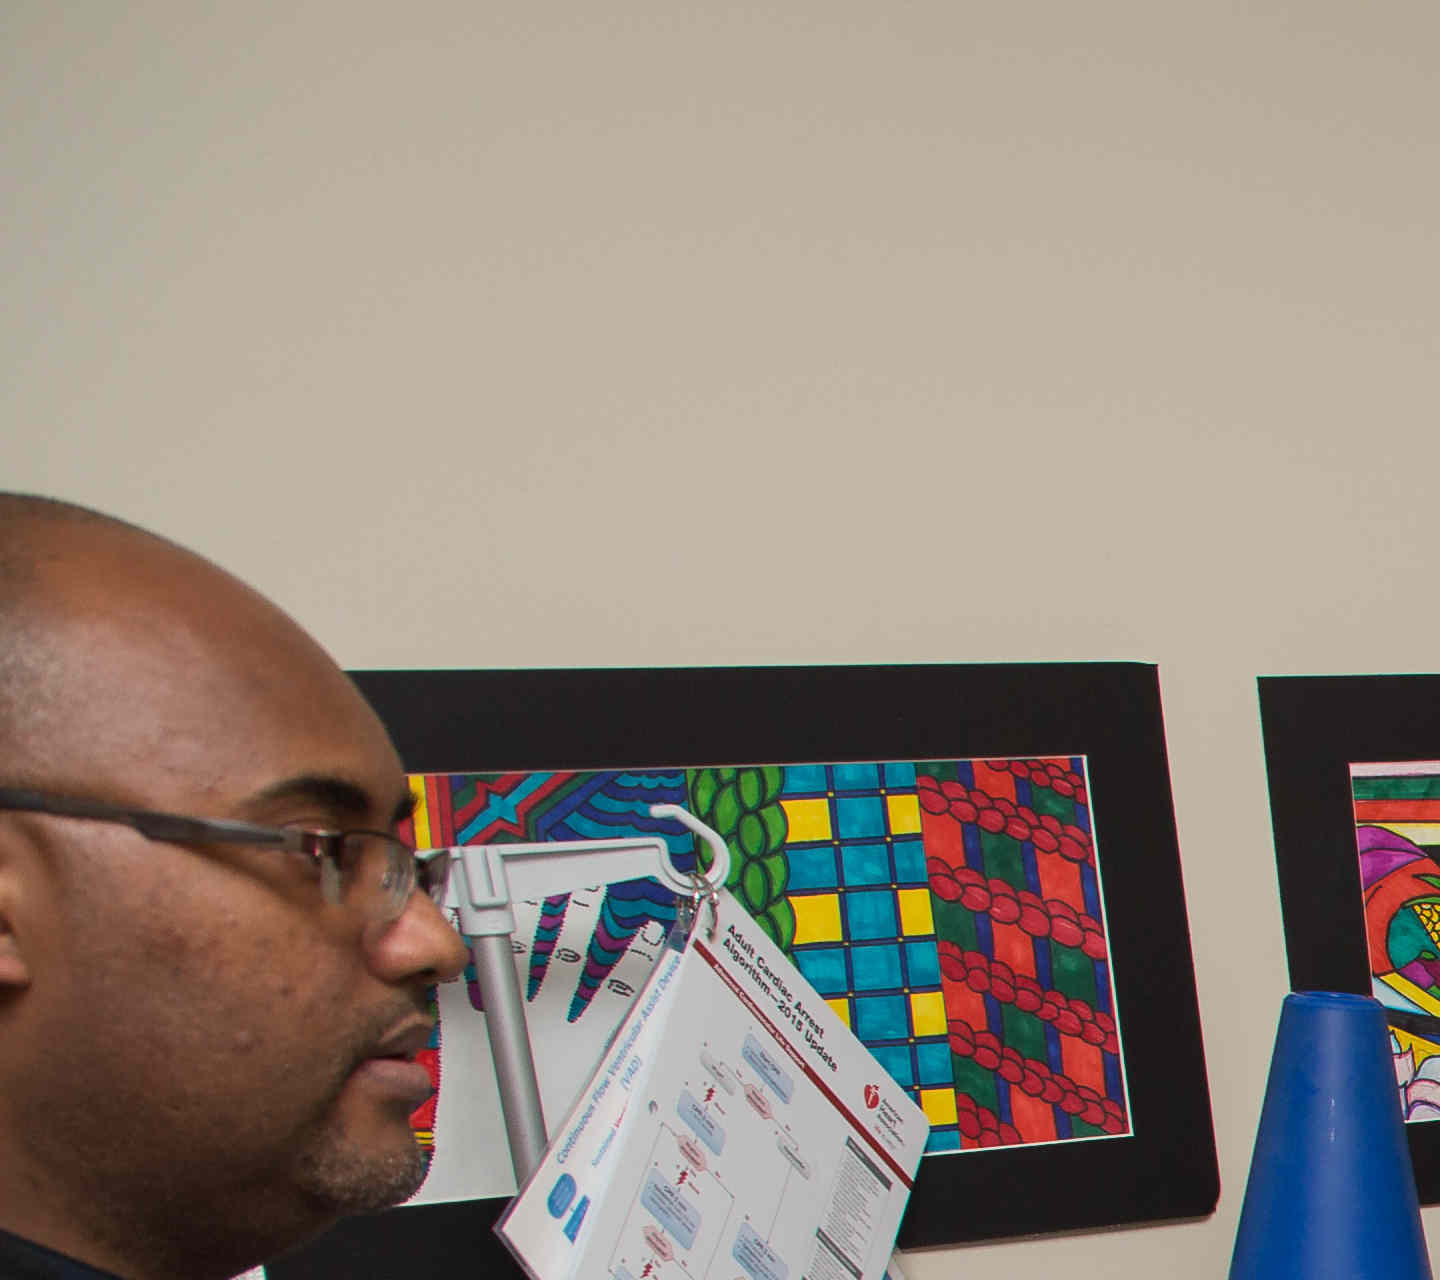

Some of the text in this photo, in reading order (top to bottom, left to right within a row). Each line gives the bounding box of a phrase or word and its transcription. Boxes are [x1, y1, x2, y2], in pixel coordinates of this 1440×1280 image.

[727, 924, 825, 1040] Adult Cardiac Arrest
[804, 1031, 838, 1073] Update
